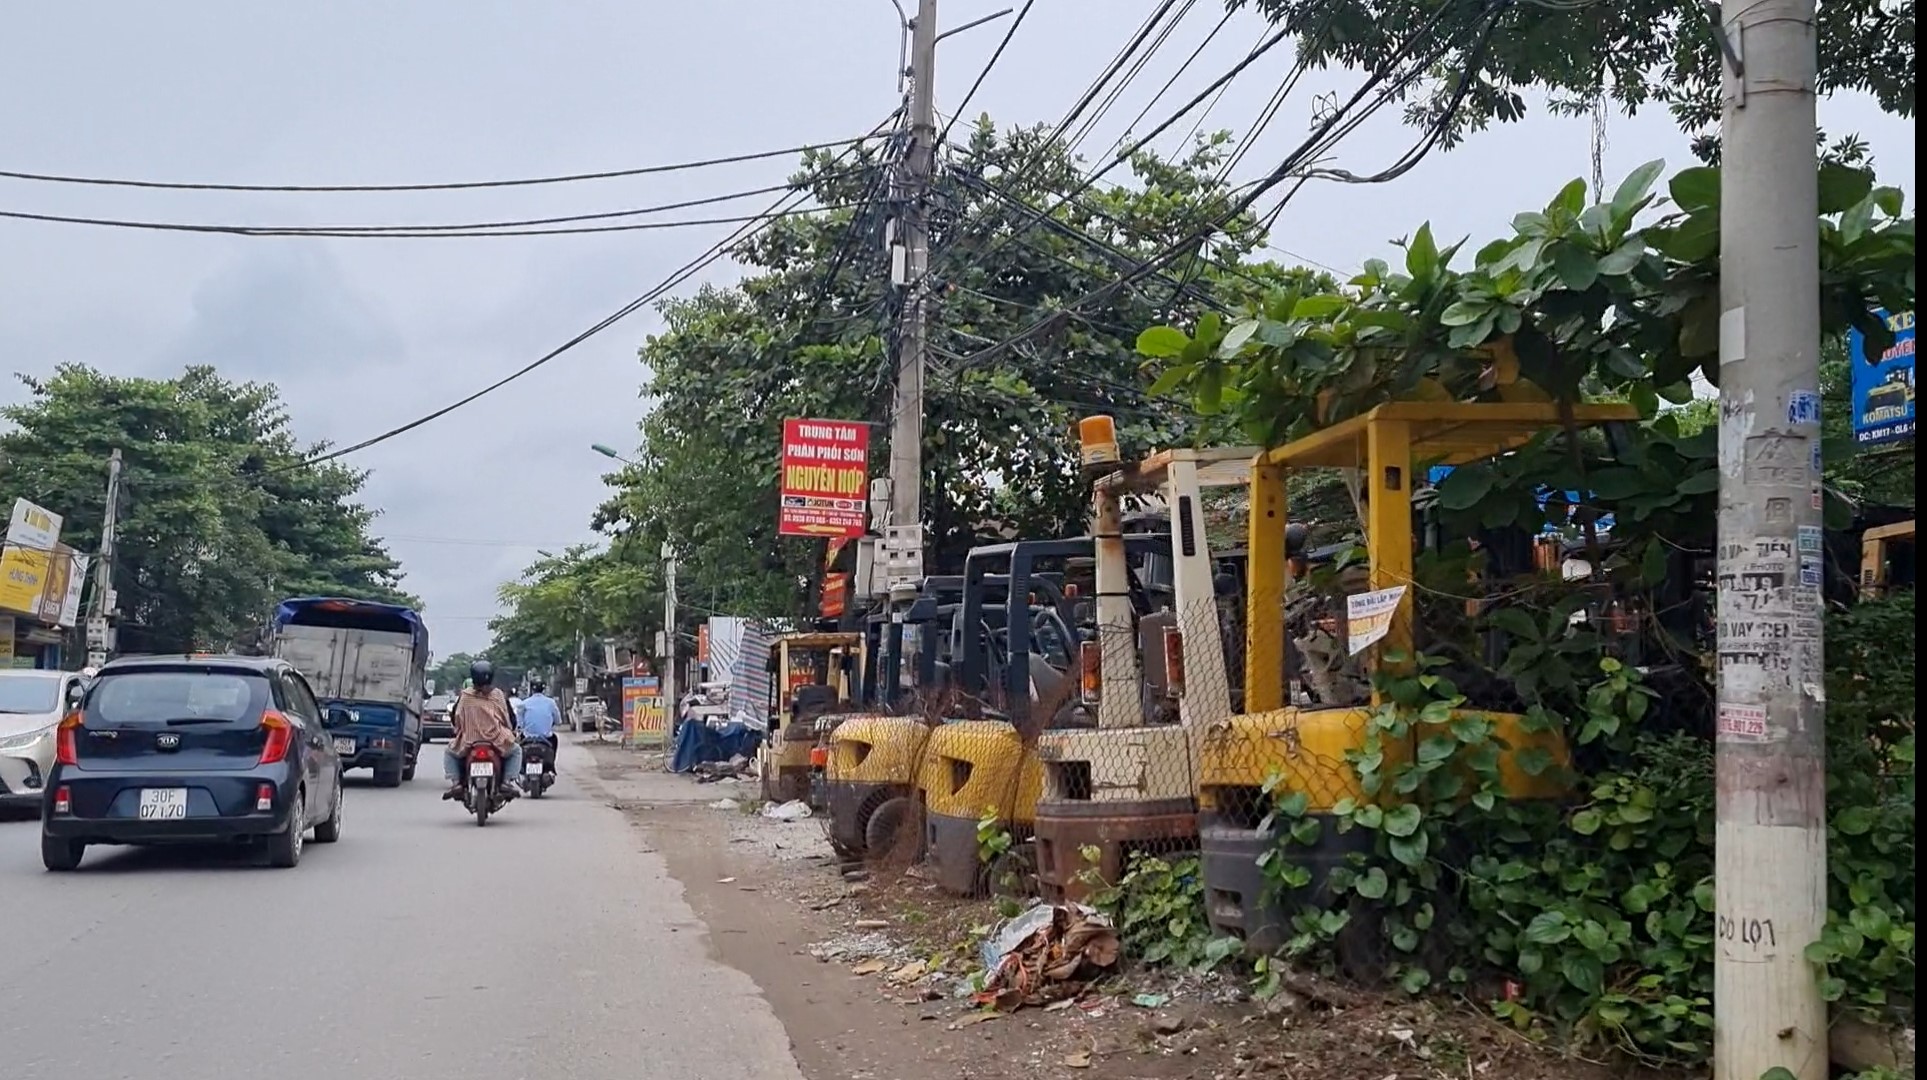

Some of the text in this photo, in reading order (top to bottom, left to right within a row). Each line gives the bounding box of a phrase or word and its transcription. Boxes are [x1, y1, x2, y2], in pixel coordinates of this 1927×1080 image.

[1862, 404, 1908, 425] KOMATSU
[799, 424, 857, 441] TRUNG TÂM
[787, 442, 815, 459] PHÂN
[843, 447, 865, 462] SƠN
[838, 466, 864, 498] HỢP
[1731, 622, 1754, 638] VAY
[159, 735, 178, 745] KIA
[151, 790, 175, 803] 30F
